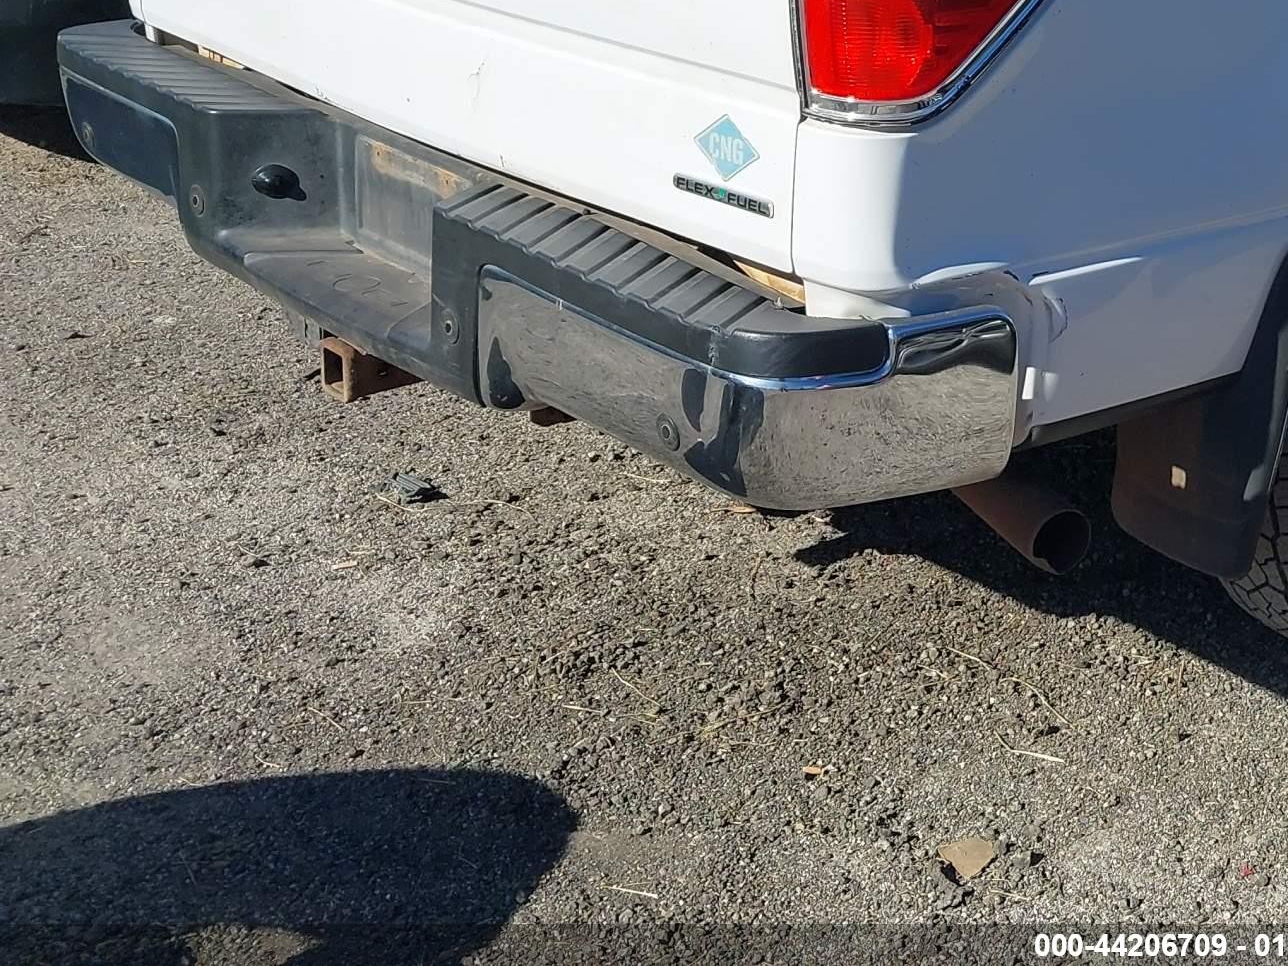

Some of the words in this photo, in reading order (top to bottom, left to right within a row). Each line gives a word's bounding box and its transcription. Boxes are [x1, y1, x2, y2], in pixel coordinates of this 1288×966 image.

[708, 132, 744, 165] CNG
[676, 175, 715, 199] FLEX
[726, 192, 770, 216] FUEL
